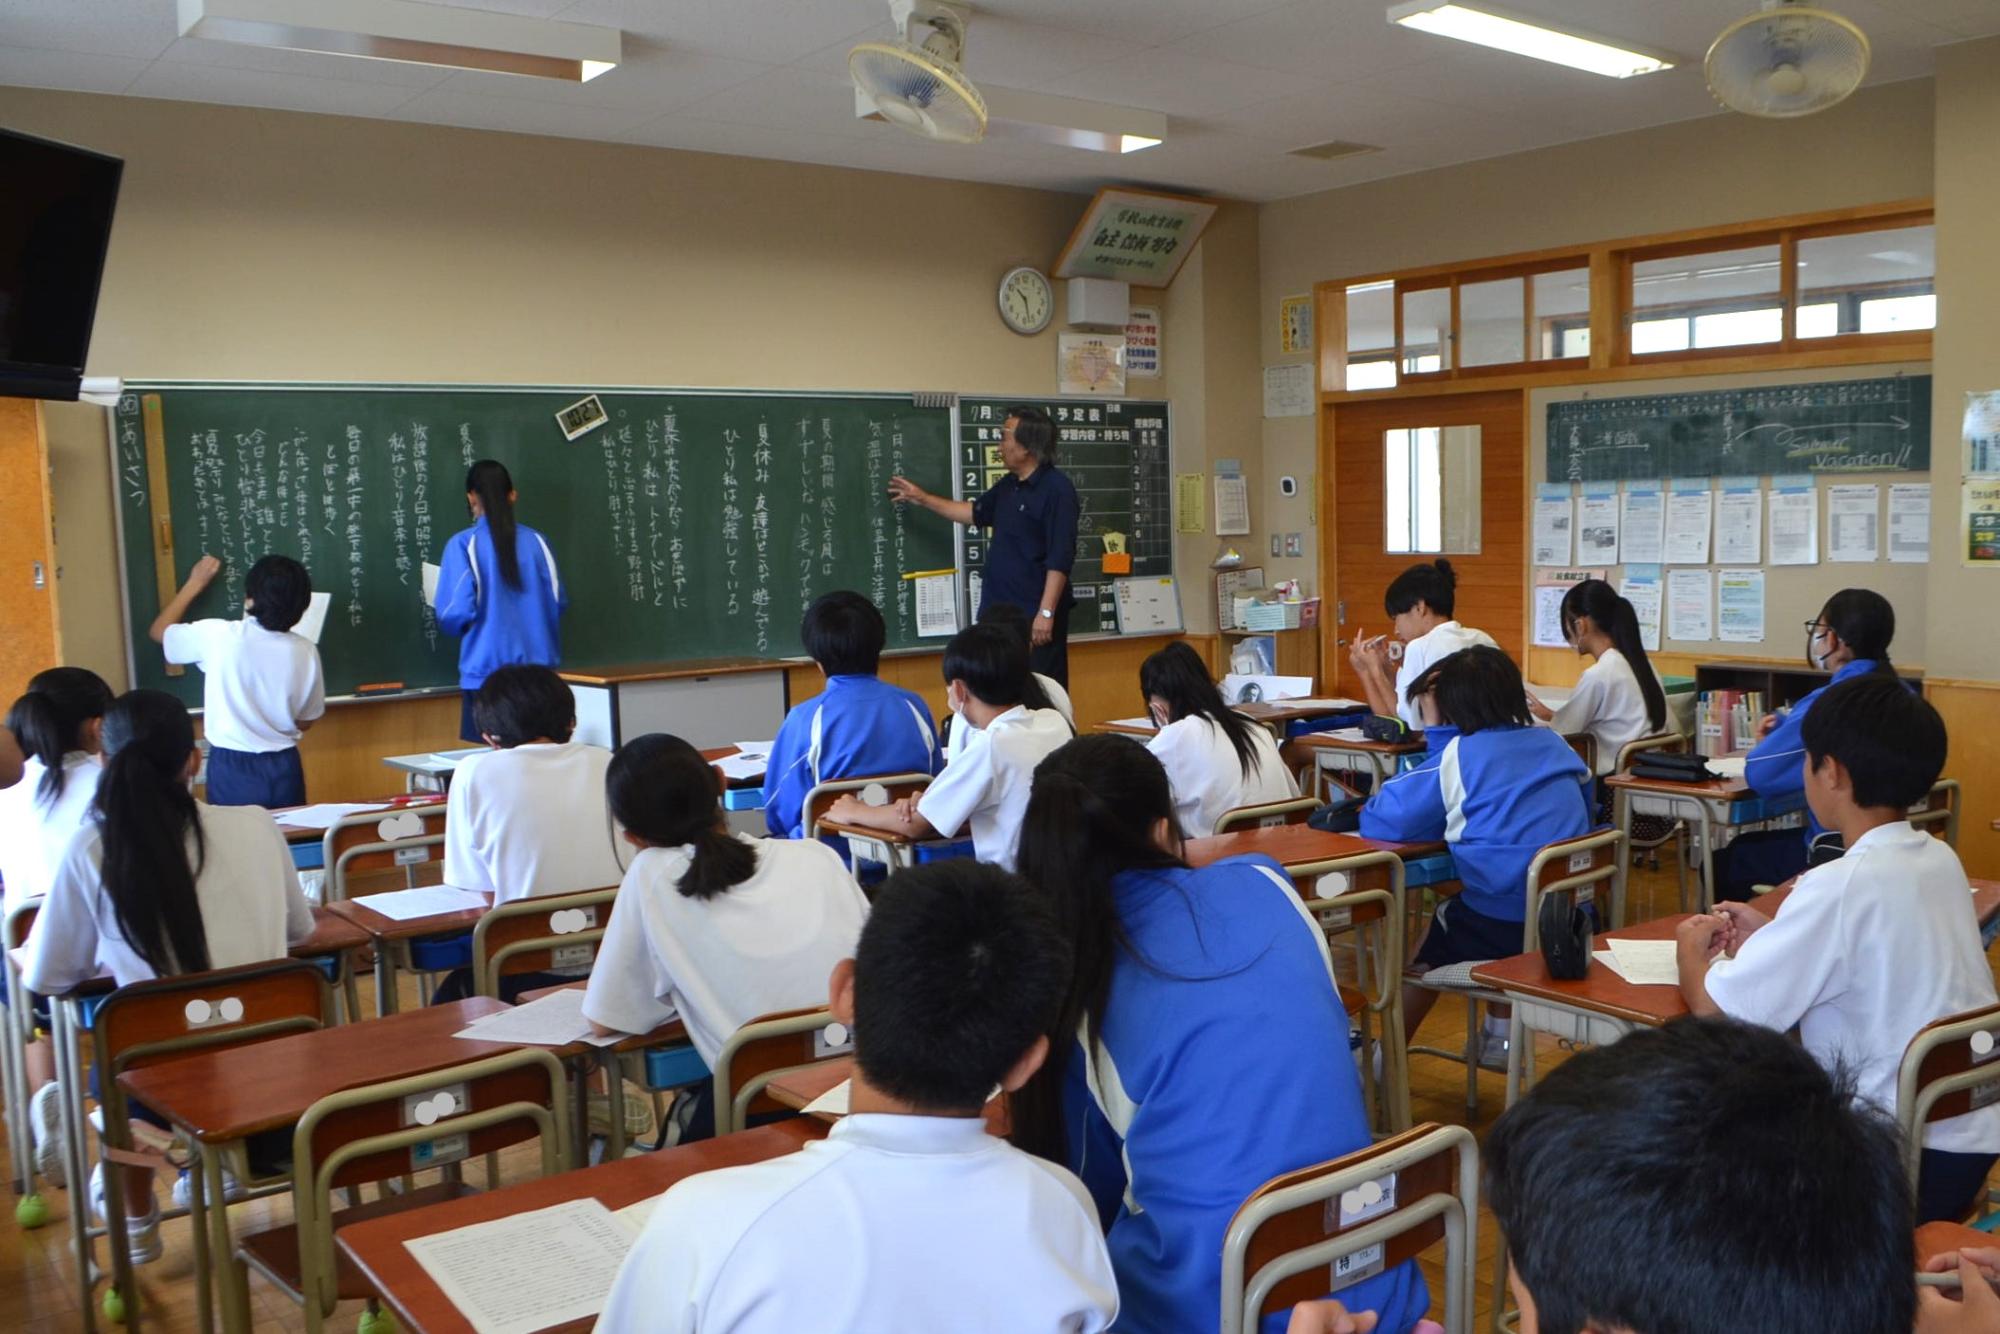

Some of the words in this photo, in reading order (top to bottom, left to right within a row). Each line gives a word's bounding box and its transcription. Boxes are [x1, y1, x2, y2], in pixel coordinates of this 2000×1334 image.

[980, 406, 992, 420] 月
[1057, 407, 1101, 422] 予定表
[1060, 428, 1130, 441] 学習内容・持ち物
[752, 423, 773, 484] 夏休み
[967, 446, 974, 462] 1
[966, 472, 978, 487] 2
[969, 546, 979, 560] 5
